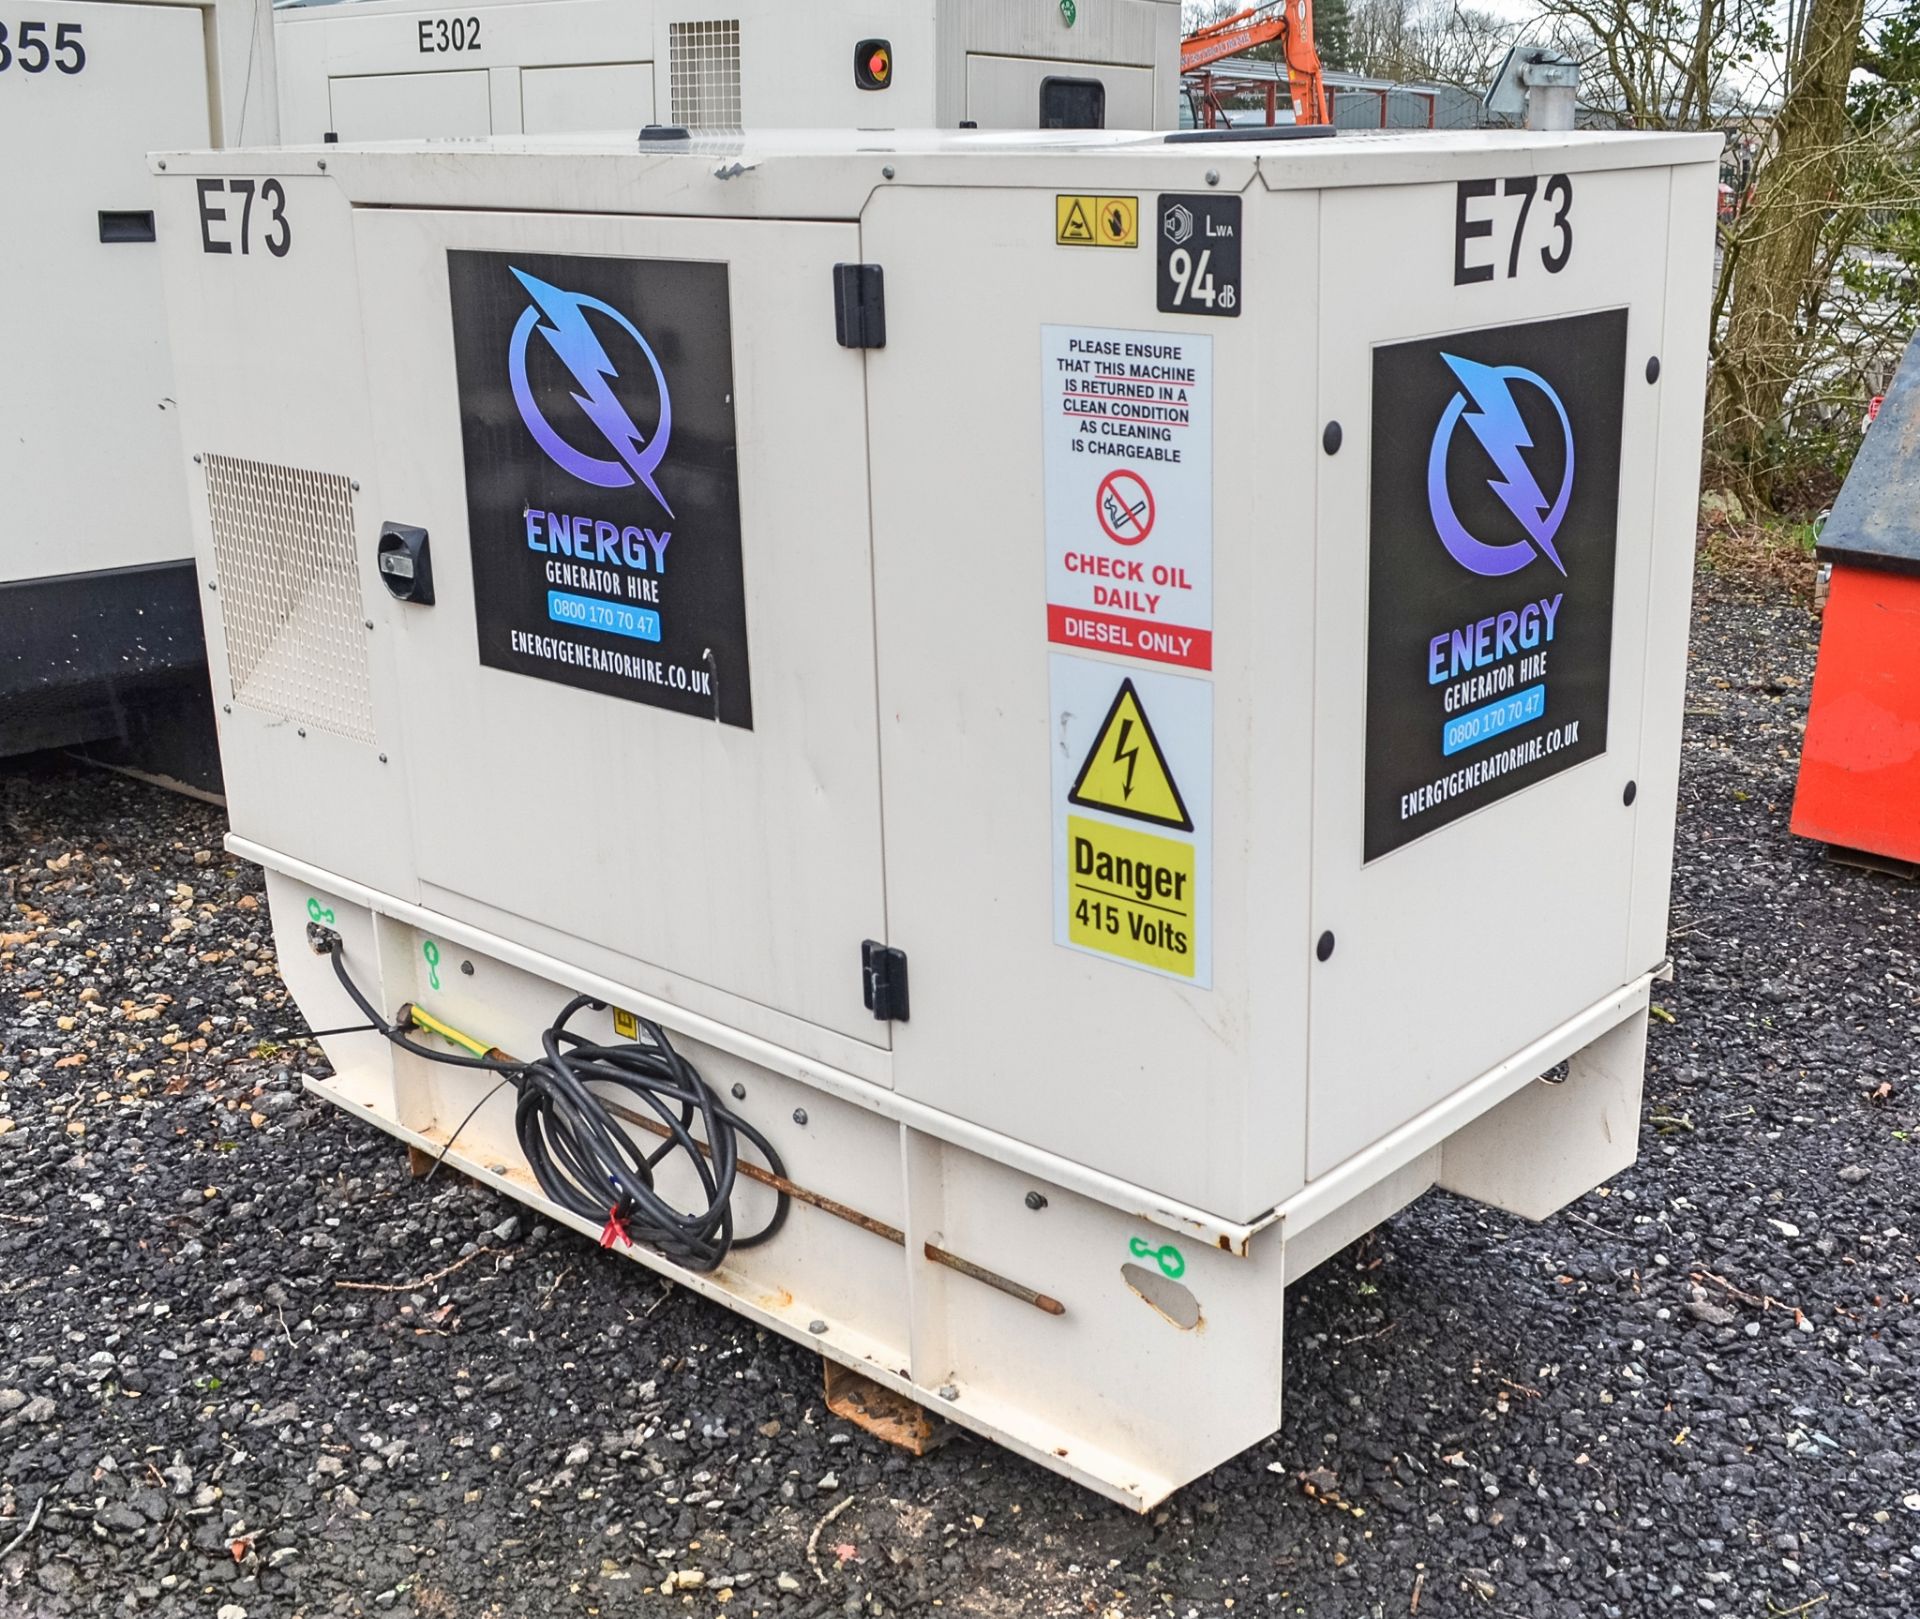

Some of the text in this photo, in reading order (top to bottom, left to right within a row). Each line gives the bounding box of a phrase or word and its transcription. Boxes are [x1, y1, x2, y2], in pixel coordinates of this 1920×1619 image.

[418, 17, 481, 53] E302
[196, 178, 291, 258] E73
[1455, 173, 1573, 286] E73
[1169, 248, 1236, 309] 94 dB
[1057, 358, 1195, 381] THAT THIS MACHINE
[1069, 339, 1182, 360] PLEASE ENSURE
[1063, 398, 1189, 422] CLEAN CONDITION
[1065, 379, 1187, 402] IS RETURNED IN A
[1072, 439, 1181, 463] IS CHARGEABLE
[1080, 420, 1172, 441] AS CLEANING
[526, 509, 672, 574] ENERGY
[545, 560, 660, 604] GENERATOR HIRE
[1064, 552, 1192, 590] CHECK OIL
[553, 598, 654, 634] 0800 170 70 47
[1094, 585, 1160, 614] DAILY
[1065, 617, 1192, 657] DIESEL ONLY
[1429, 593, 1563, 685] ENERGY
[510, 630, 711, 696] ENERGYGENERATORHIRE.CO.UK
[1444, 651, 1547, 712] GENERATOR HIRE
[1449, 694, 1539, 746] 0800 170 70 47
[1401, 720, 1579, 820] ENERGYGENERATORHIRE.CO.UK
[1075, 836, 1187, 901] Danger
[1075, 898, 1187, 955] 415 Volts
